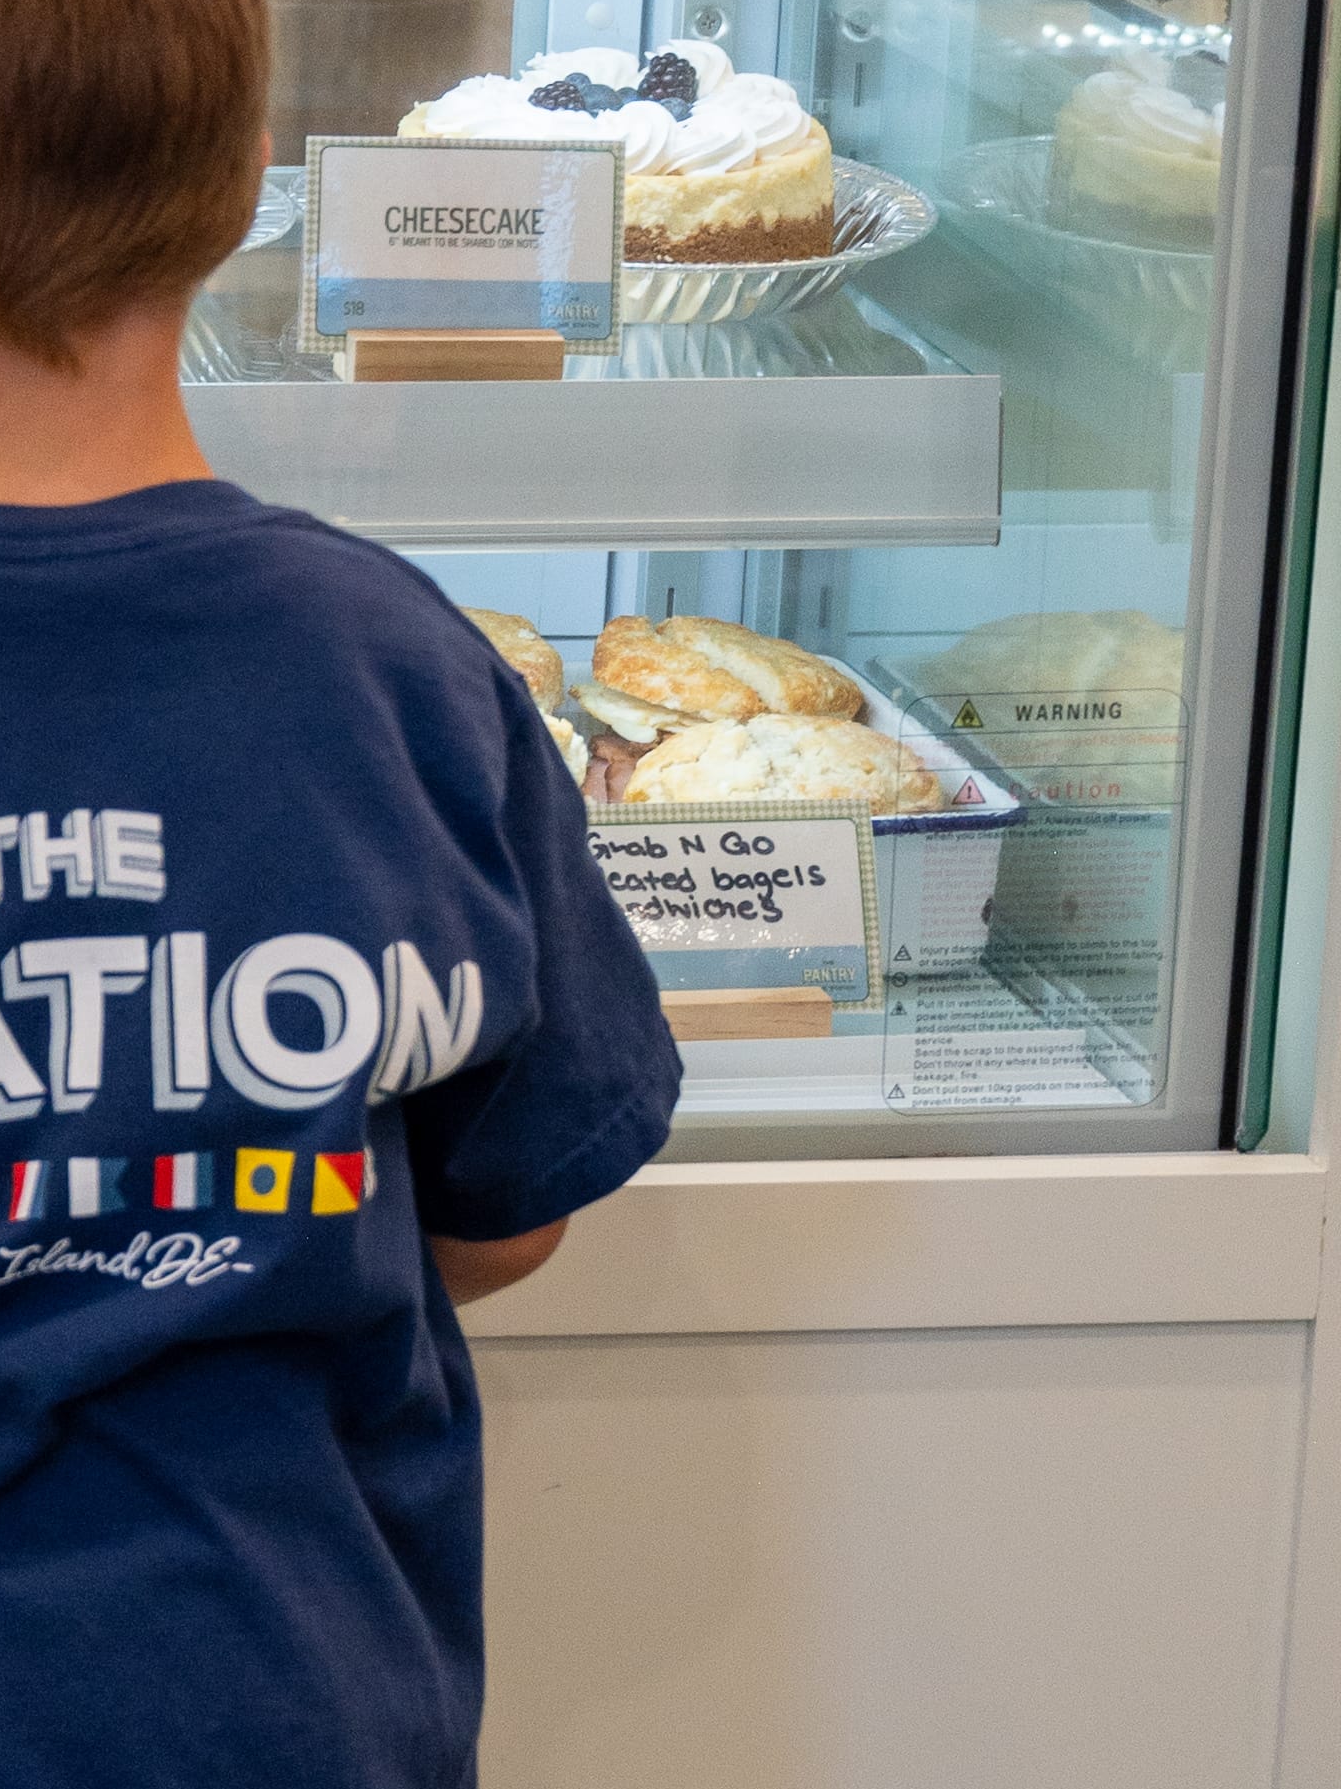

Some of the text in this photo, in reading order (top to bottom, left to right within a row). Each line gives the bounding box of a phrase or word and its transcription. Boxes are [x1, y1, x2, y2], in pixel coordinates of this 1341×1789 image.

[384, 207, 546, 235] CHEESECAKE
[402, 237, 432, 248] MEANT
[434, 238, 445, 248] TO
[447, 238, 459, 248] BE
[461, 238, 496, 249] SHARED
[1015, 702, 1123, 721] WARNING
[587, 832, 775, 860] Grab N Go
[607, 865, 826, 898] eated bagels
[625, 894, 784, 923] ndwiches
[803, 969, 855, 981] PANTRY
